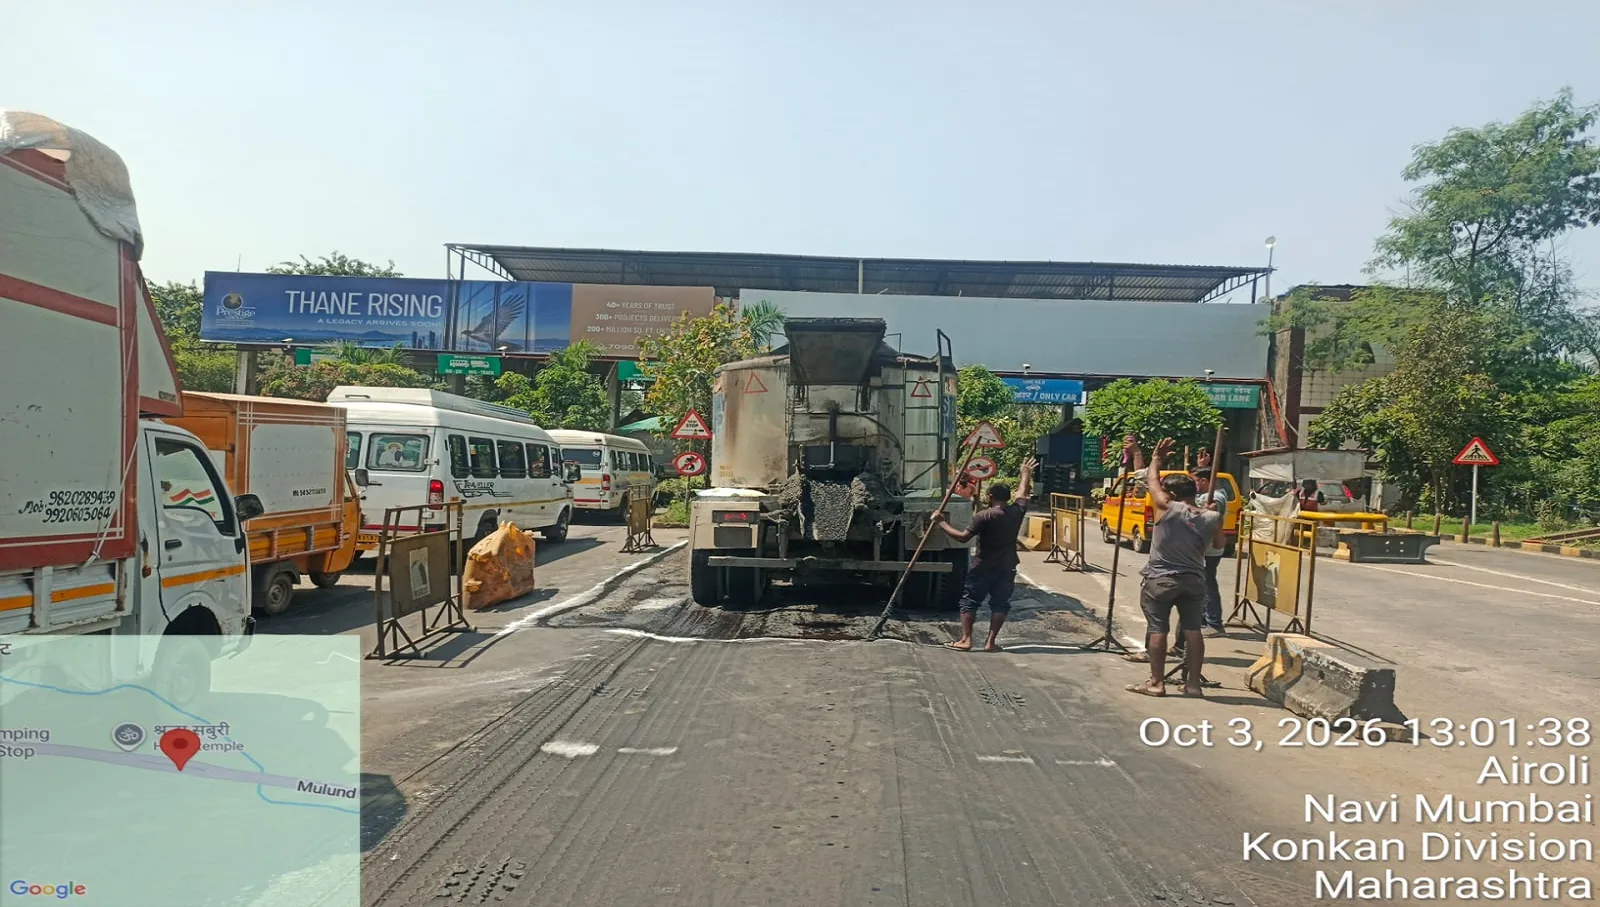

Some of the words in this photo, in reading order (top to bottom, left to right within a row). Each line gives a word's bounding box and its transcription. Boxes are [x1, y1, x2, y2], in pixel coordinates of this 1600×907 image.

[216, 306, 256, 320] Prestige
[285, 290, 362, 315] THANE
[367, 292, 443, 318] RISING
